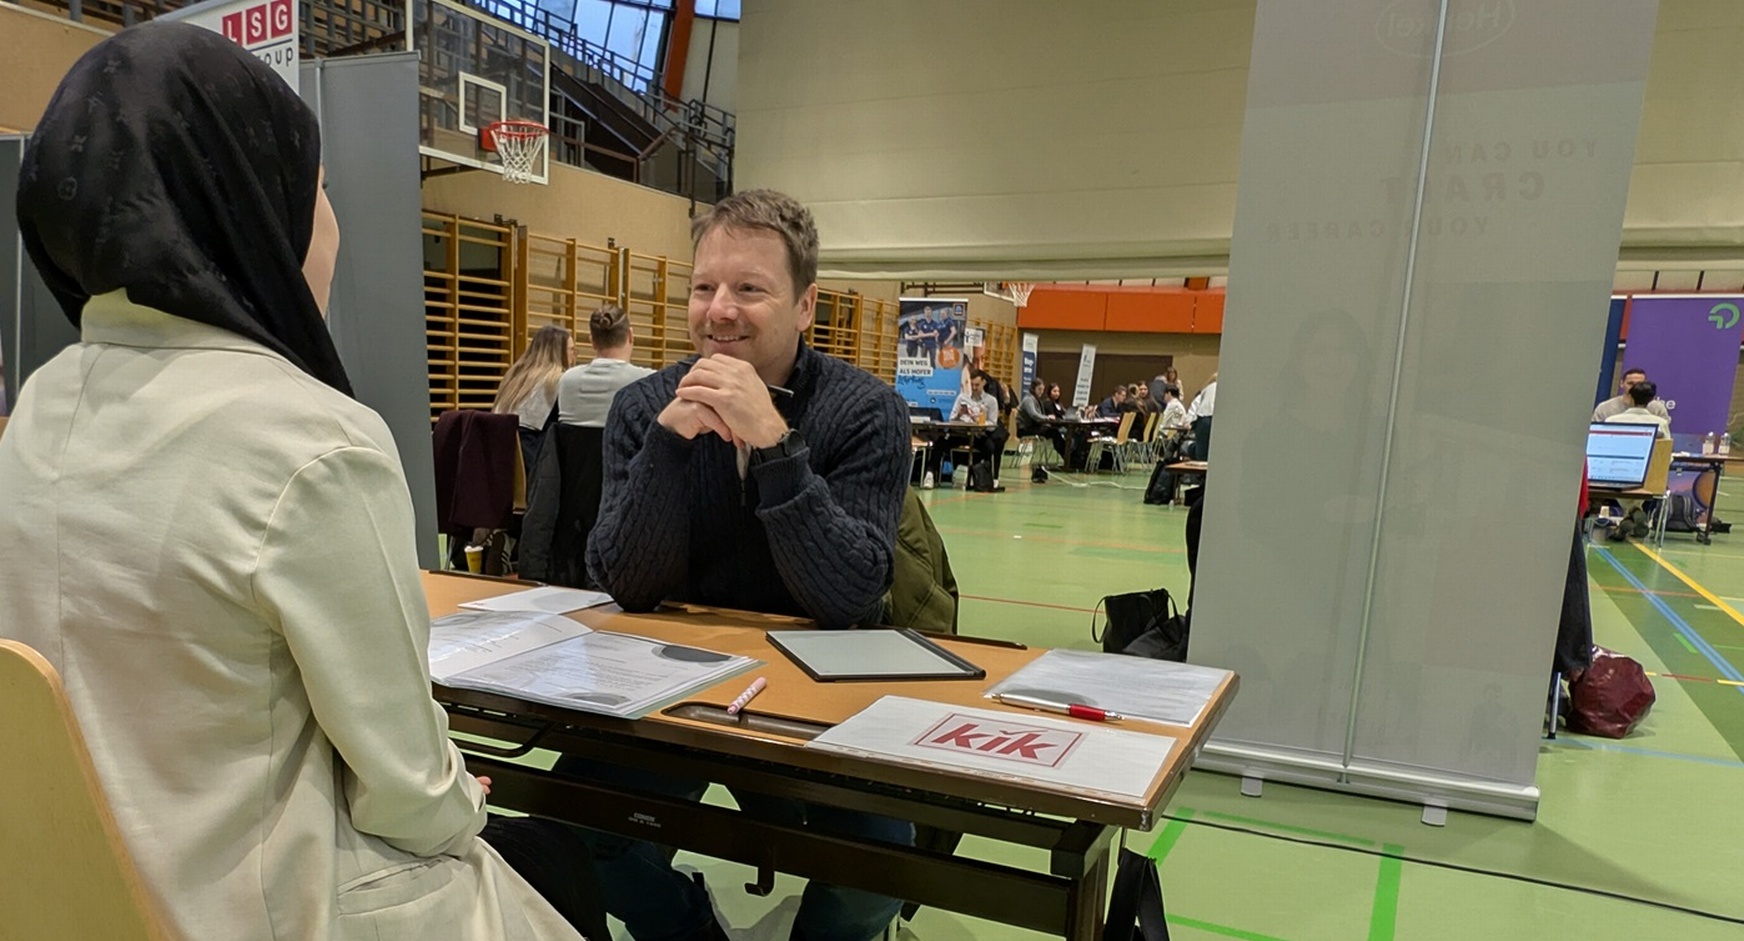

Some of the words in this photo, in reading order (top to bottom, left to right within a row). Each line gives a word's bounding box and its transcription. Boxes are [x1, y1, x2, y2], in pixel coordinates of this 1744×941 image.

[228, 4, 288, 42] LSG
[264, 47, 293, 67] oup
[931, 723, 1057, 759] kik
